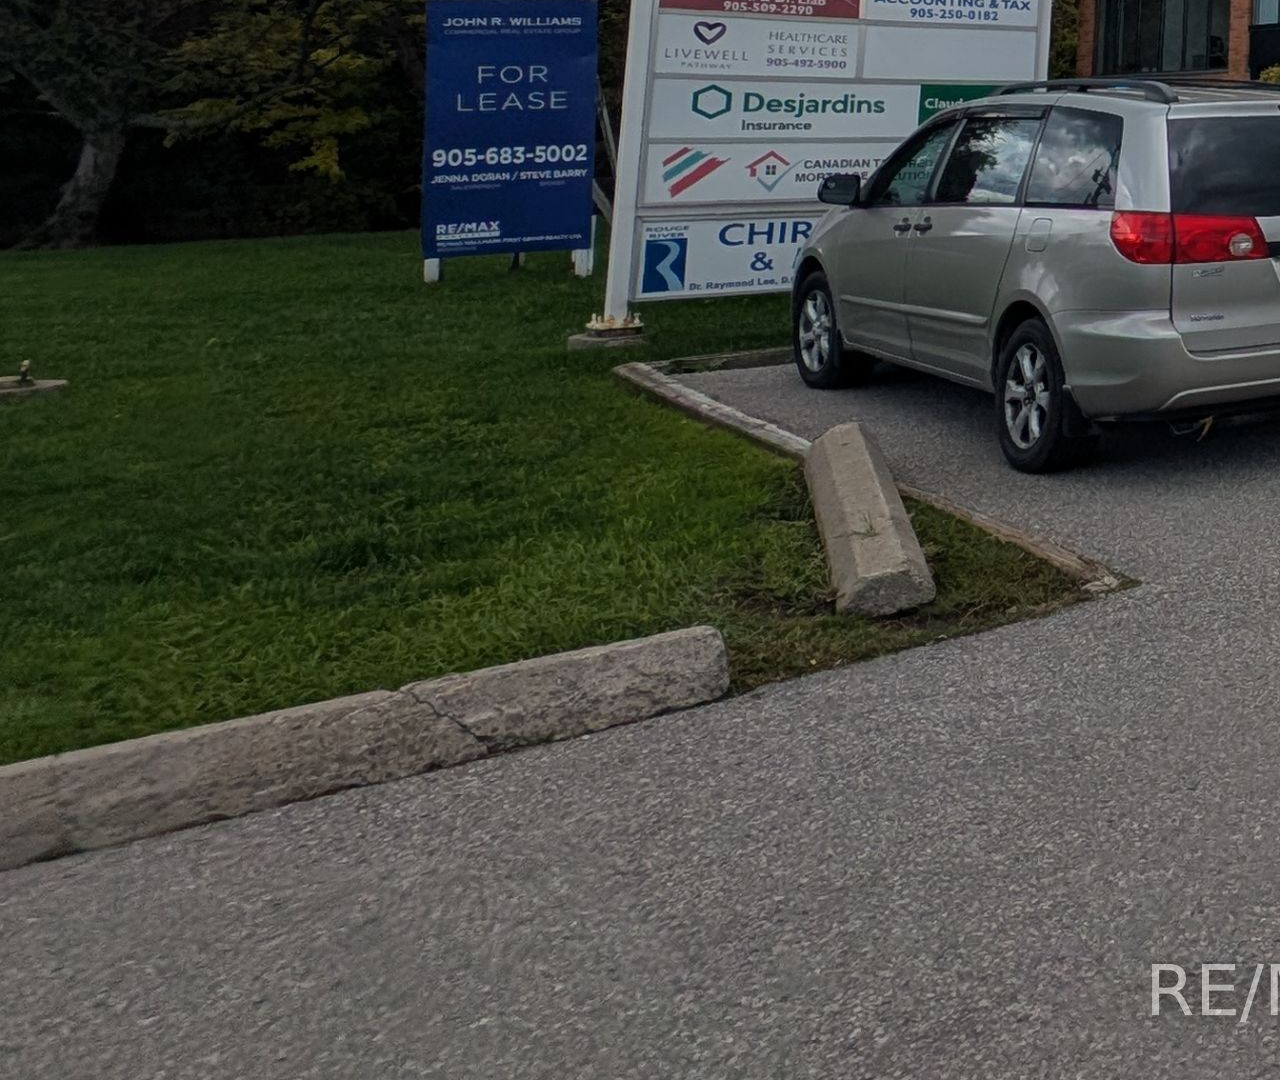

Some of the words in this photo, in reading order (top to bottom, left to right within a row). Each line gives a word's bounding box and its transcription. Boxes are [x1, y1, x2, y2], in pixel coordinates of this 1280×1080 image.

[723, 1, 813, 16] 905-509-2290
[1002, 0, 1031, 11] TAX
[910, 8, 998, 21] 905-250-0182
[442, 18, 487, 27] JOHN
[509, 17, 582, 26] WILLIAMS
[769, 31, 848, 44] HEALTHCARE
[664, 48, 749, 61] LIVEWELL
[768, 45, 848, 57] SERVICES
[766, 58, 847, 69] 905-492-5900
[477, 65, 549, 84] FOR
[457, 91, 569, 112] LEASE
[743, 93, 885, 117] Desjardins
[741, 120, 812, 131] Insurance
[432, 144, 588, 168] 905-683-5002
[804, 159, 871, 169] CANADIAN
[431, 174, 469, 184] JENNA
[519, 170, 552, 180] STEVE
[553, 169, 588, 179] BARRY
[436, 221, 500, 234] RE/MAX
[750, 251, 774, 271] &
[705, 280, 754, 290] Raymond
